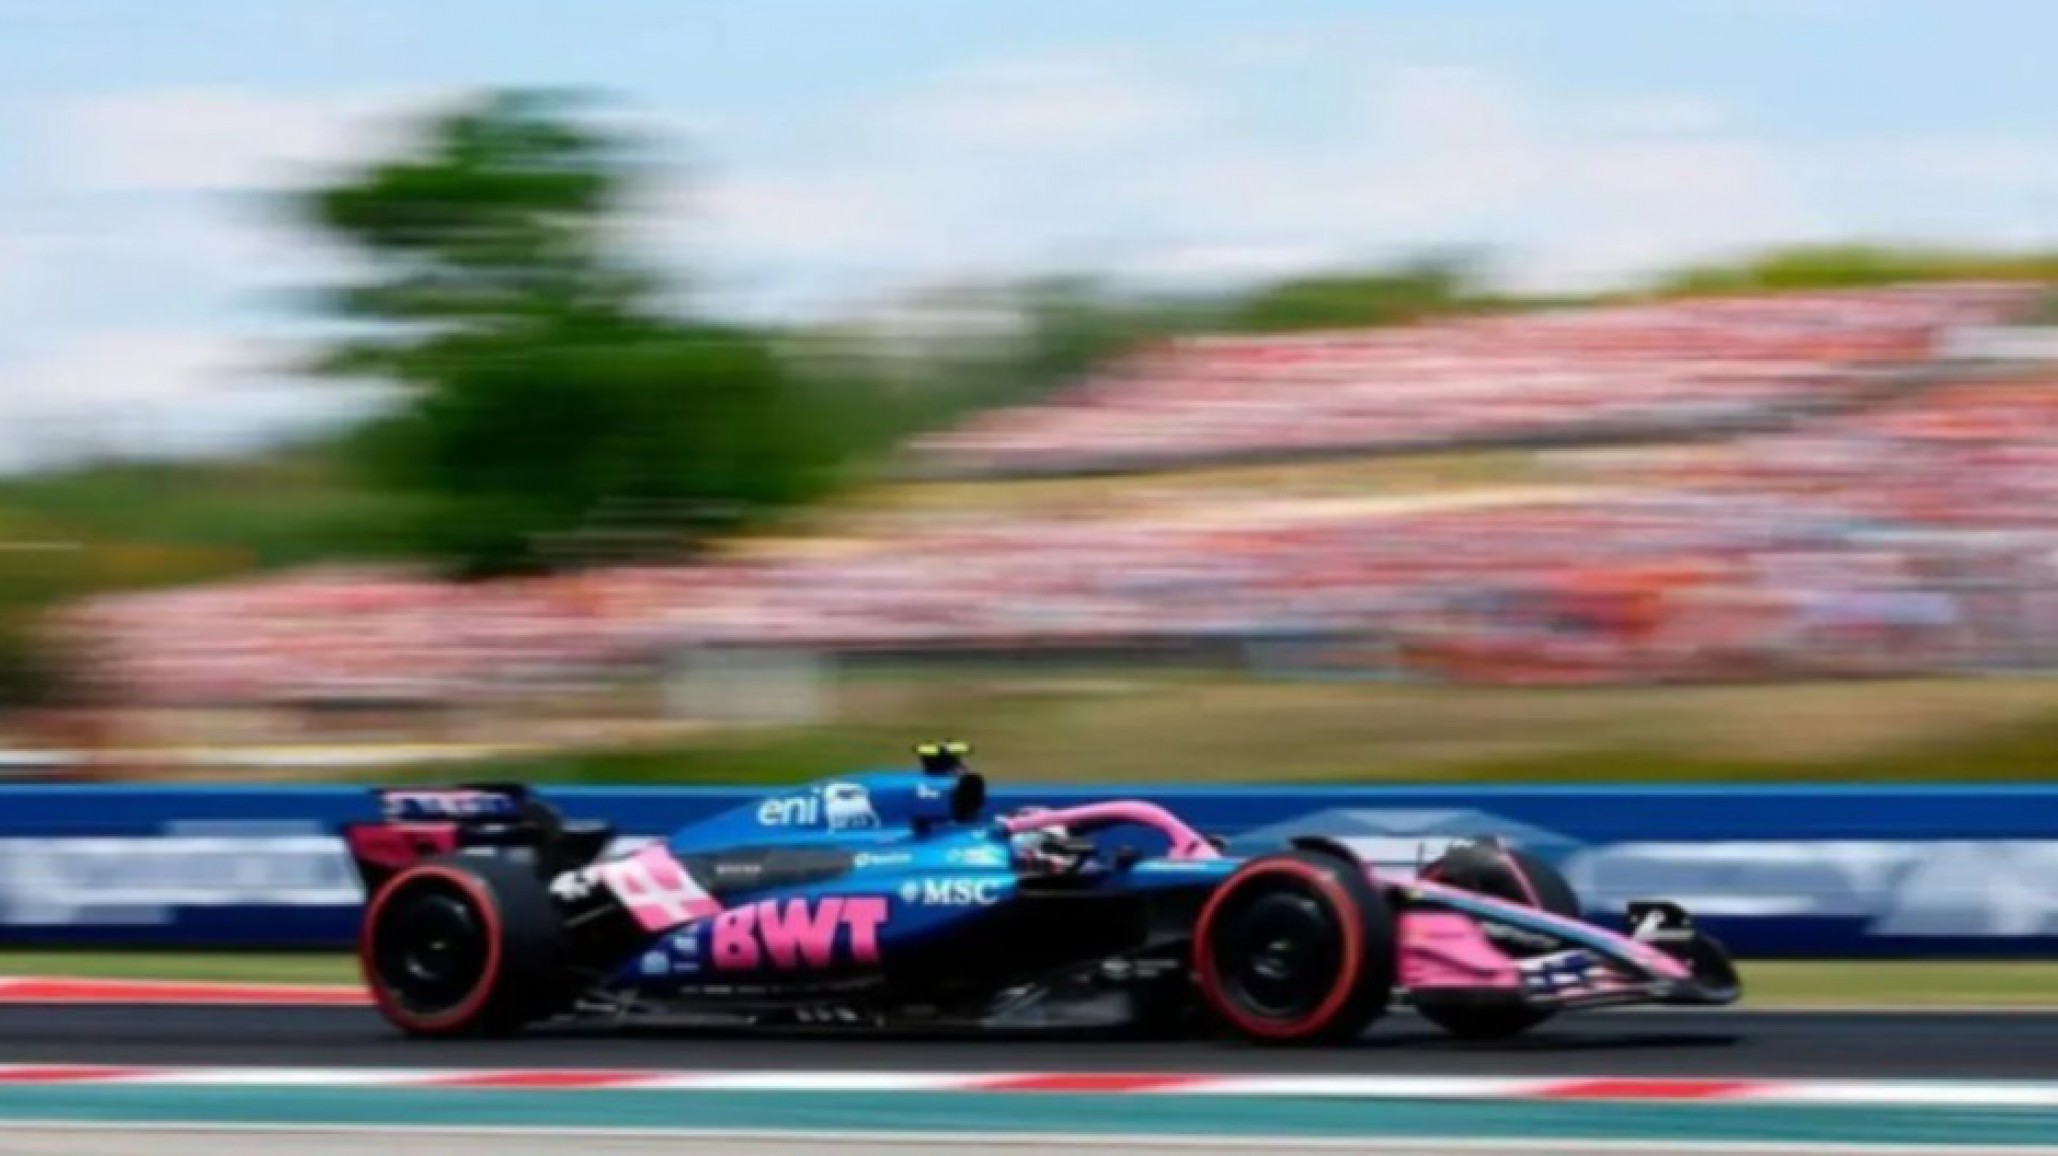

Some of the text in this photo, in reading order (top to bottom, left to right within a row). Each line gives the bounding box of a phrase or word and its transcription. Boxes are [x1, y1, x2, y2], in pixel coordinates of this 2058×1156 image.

[758, 788, 821, 826] eni
[923, 878, 999, 904] MSC
[712, 896, 888, 970] BWT
